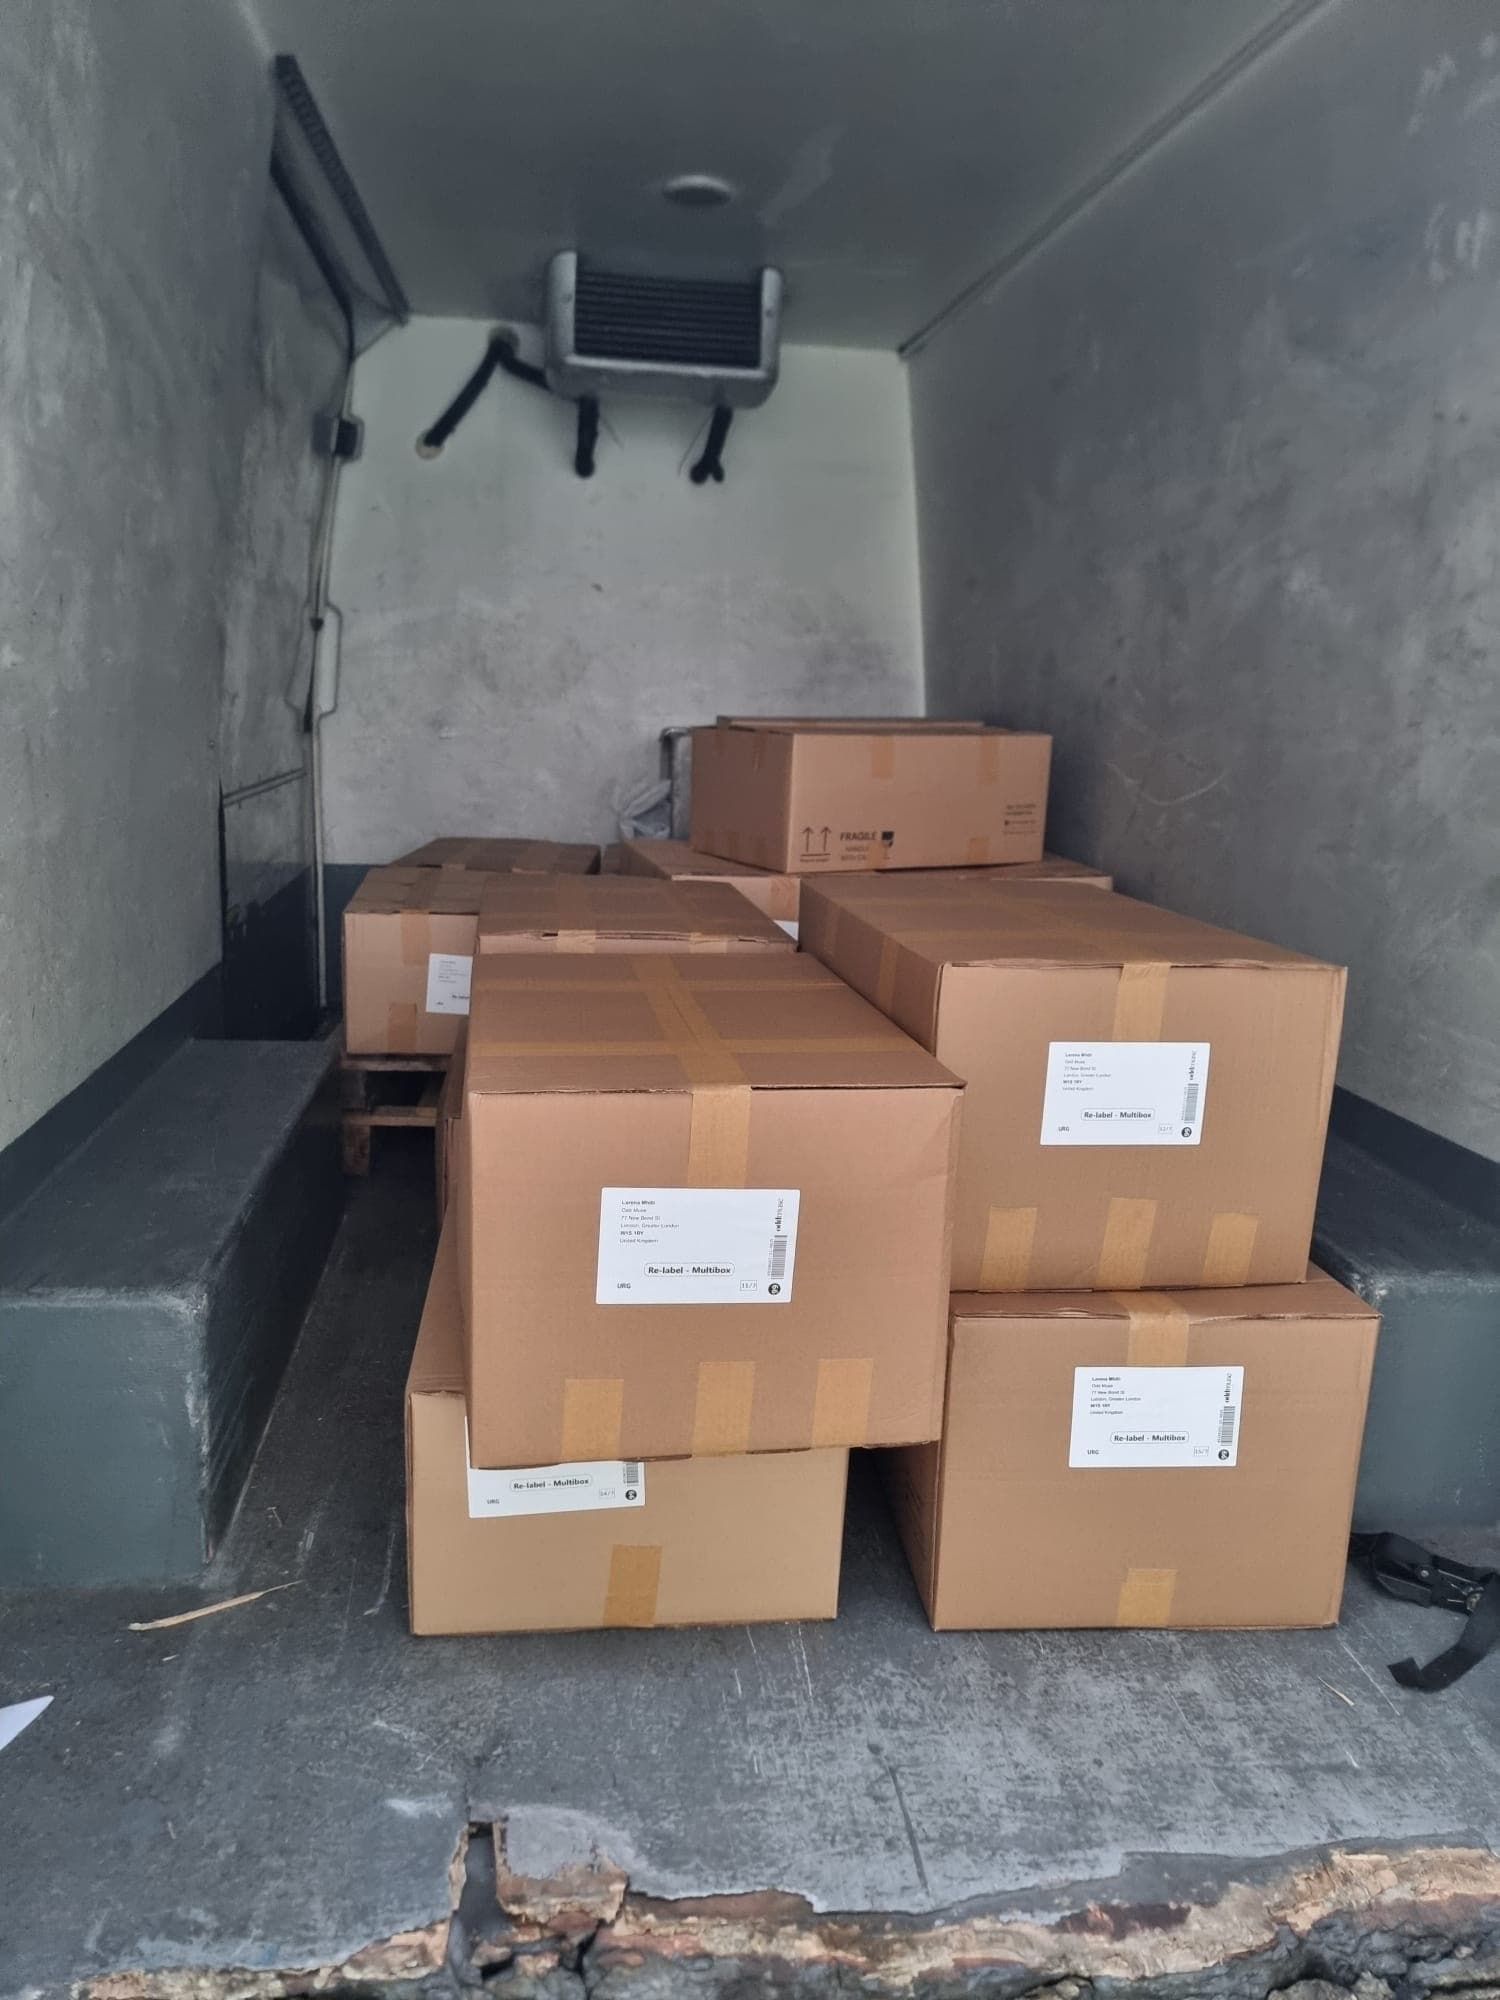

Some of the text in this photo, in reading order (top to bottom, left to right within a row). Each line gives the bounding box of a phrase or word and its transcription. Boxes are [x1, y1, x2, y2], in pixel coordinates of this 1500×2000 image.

[839, 831, 878, 841] FRAGILE
[648, 1265, 684, 1275] Re-label
[692, 1265, 731, 1275] Multibox
[616, 1282, 632, 1290] URG
[1113, 1434, 1145, 1442] Re-label
[1151, 1434, 1186, 1442] Multibox
[513, 1480, 546, 1490] Re-label
[553, 1478, 589, 1487] Multibox
